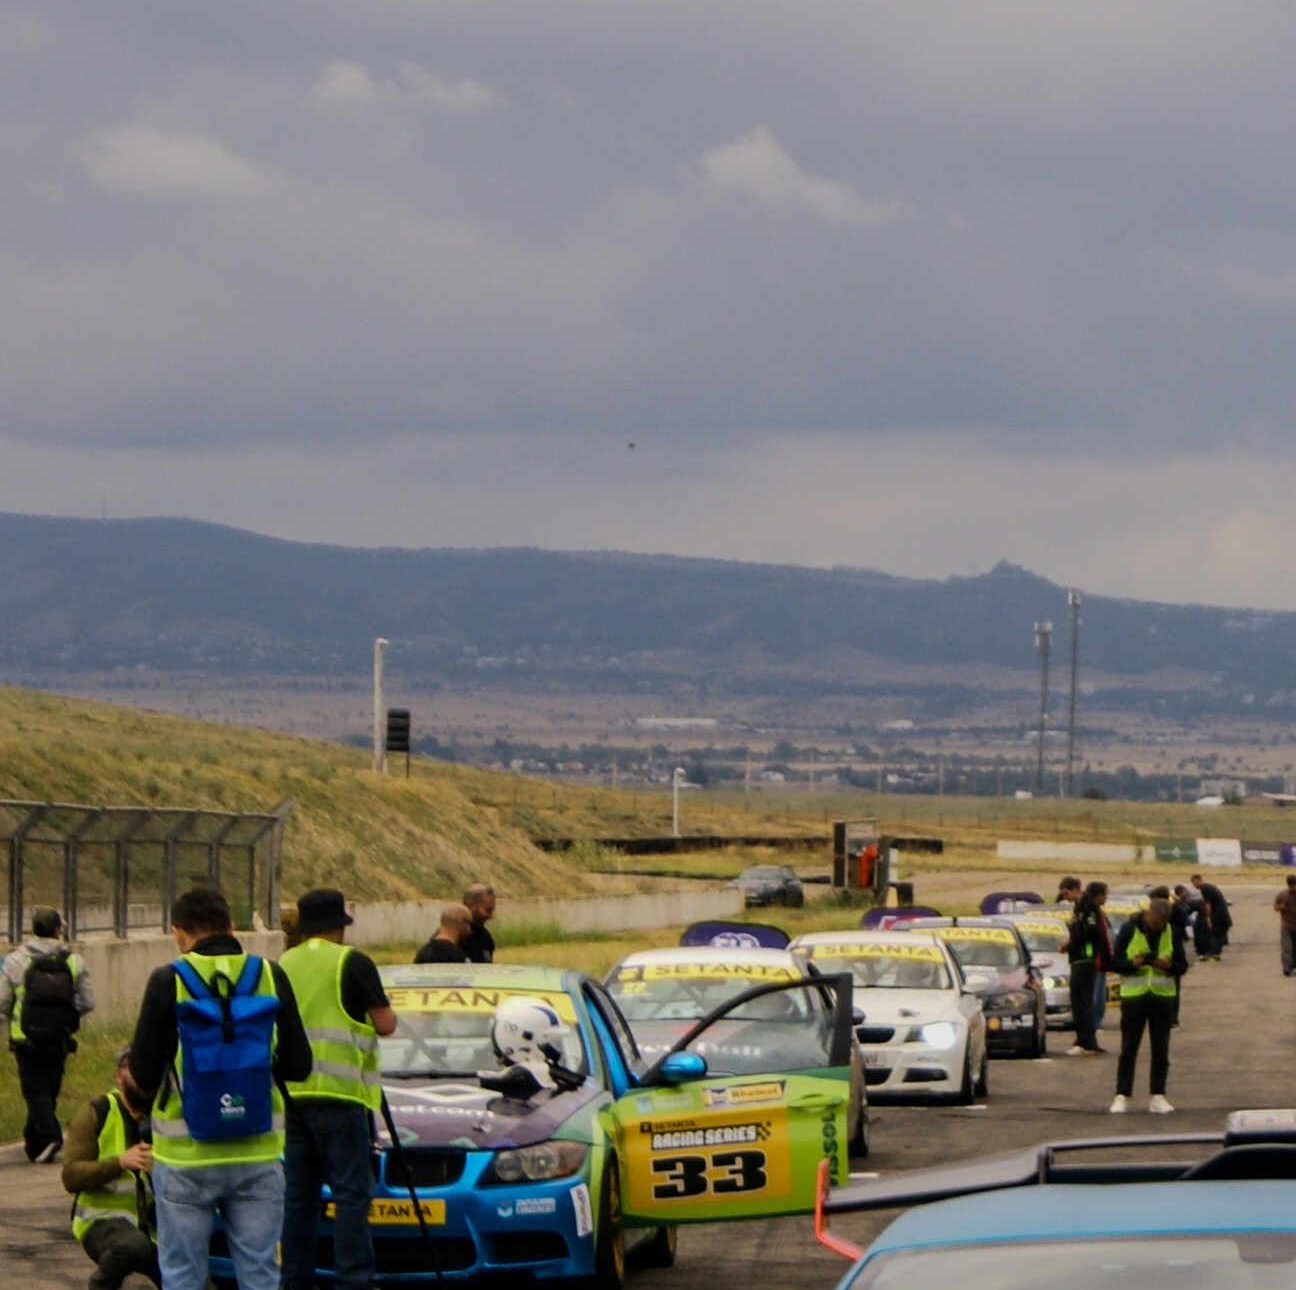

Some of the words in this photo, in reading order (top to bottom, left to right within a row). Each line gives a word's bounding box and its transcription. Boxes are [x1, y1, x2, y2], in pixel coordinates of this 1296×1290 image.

[823, 943, 934, 958] SETANTA
[655, 963, 795, 982] SETANTA
[389, 990, 555, 1007] ETAN
[654, 1119, 696, 1130] SETANTA
[653, 1132, 703, 1149] RACING
[705, 1125, 757, 1145] SERIES
[652, 1150, 767, 1199] 33
